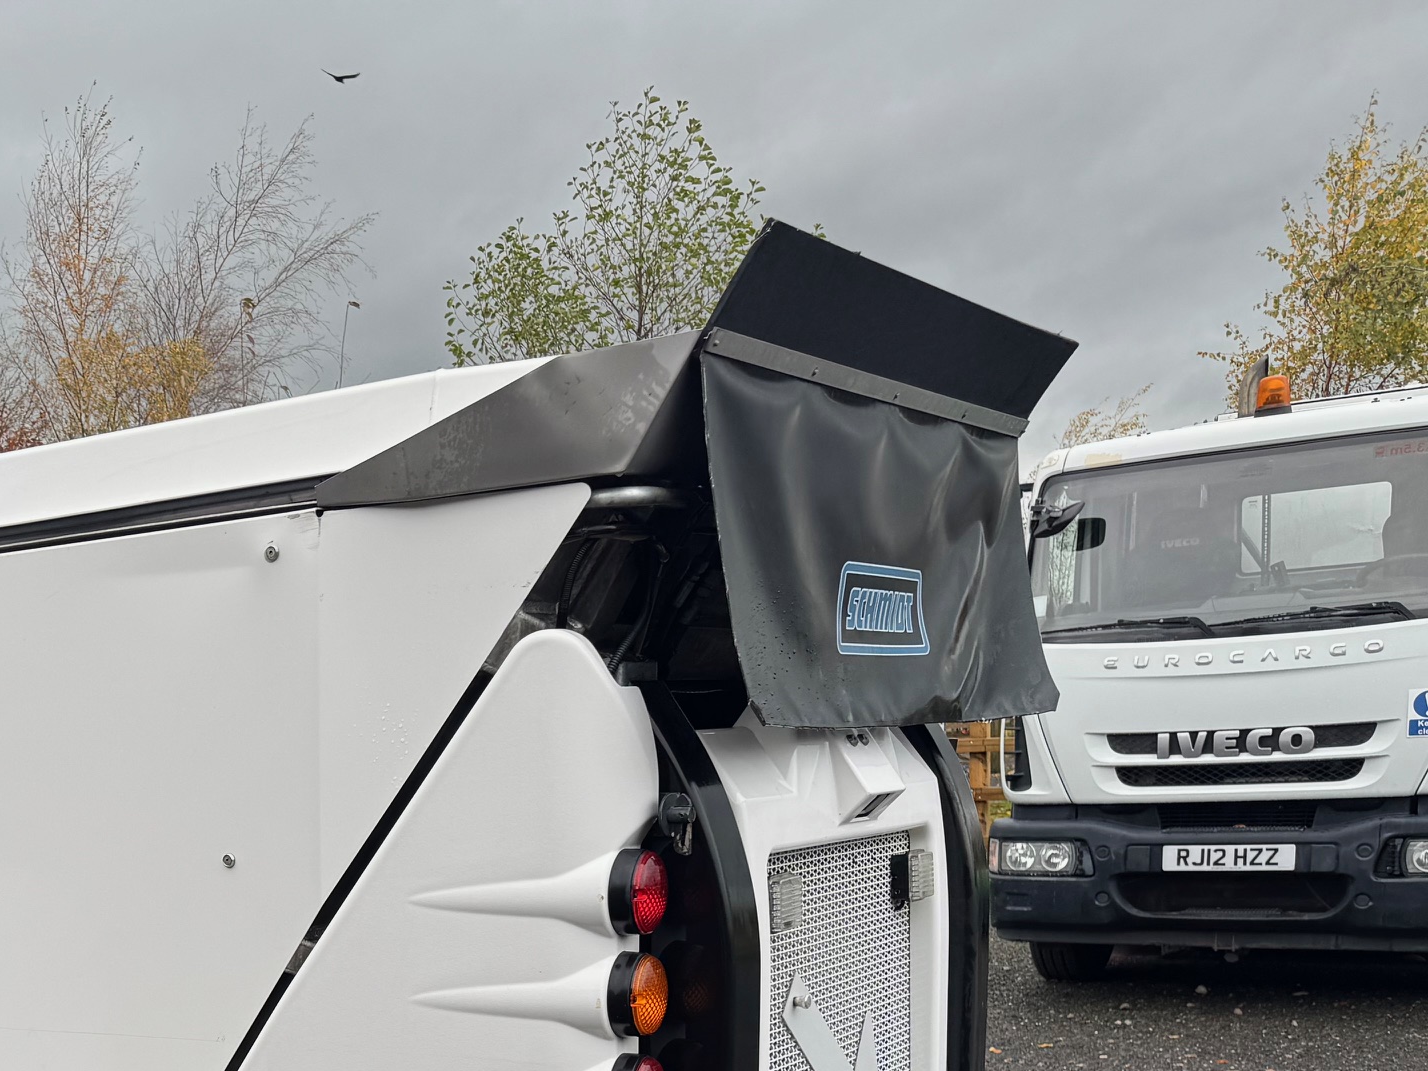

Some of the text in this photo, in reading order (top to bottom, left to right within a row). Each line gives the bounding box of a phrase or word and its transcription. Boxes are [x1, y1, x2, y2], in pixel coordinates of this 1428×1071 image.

[846, 587, 914, 633] SCHMIDT
[1103, 638, 1385, 670] EUROCARGO
[1156, 726, 1316, 759] IVECO
[1176, 847, 1279, 867] RJ12 HZZ
